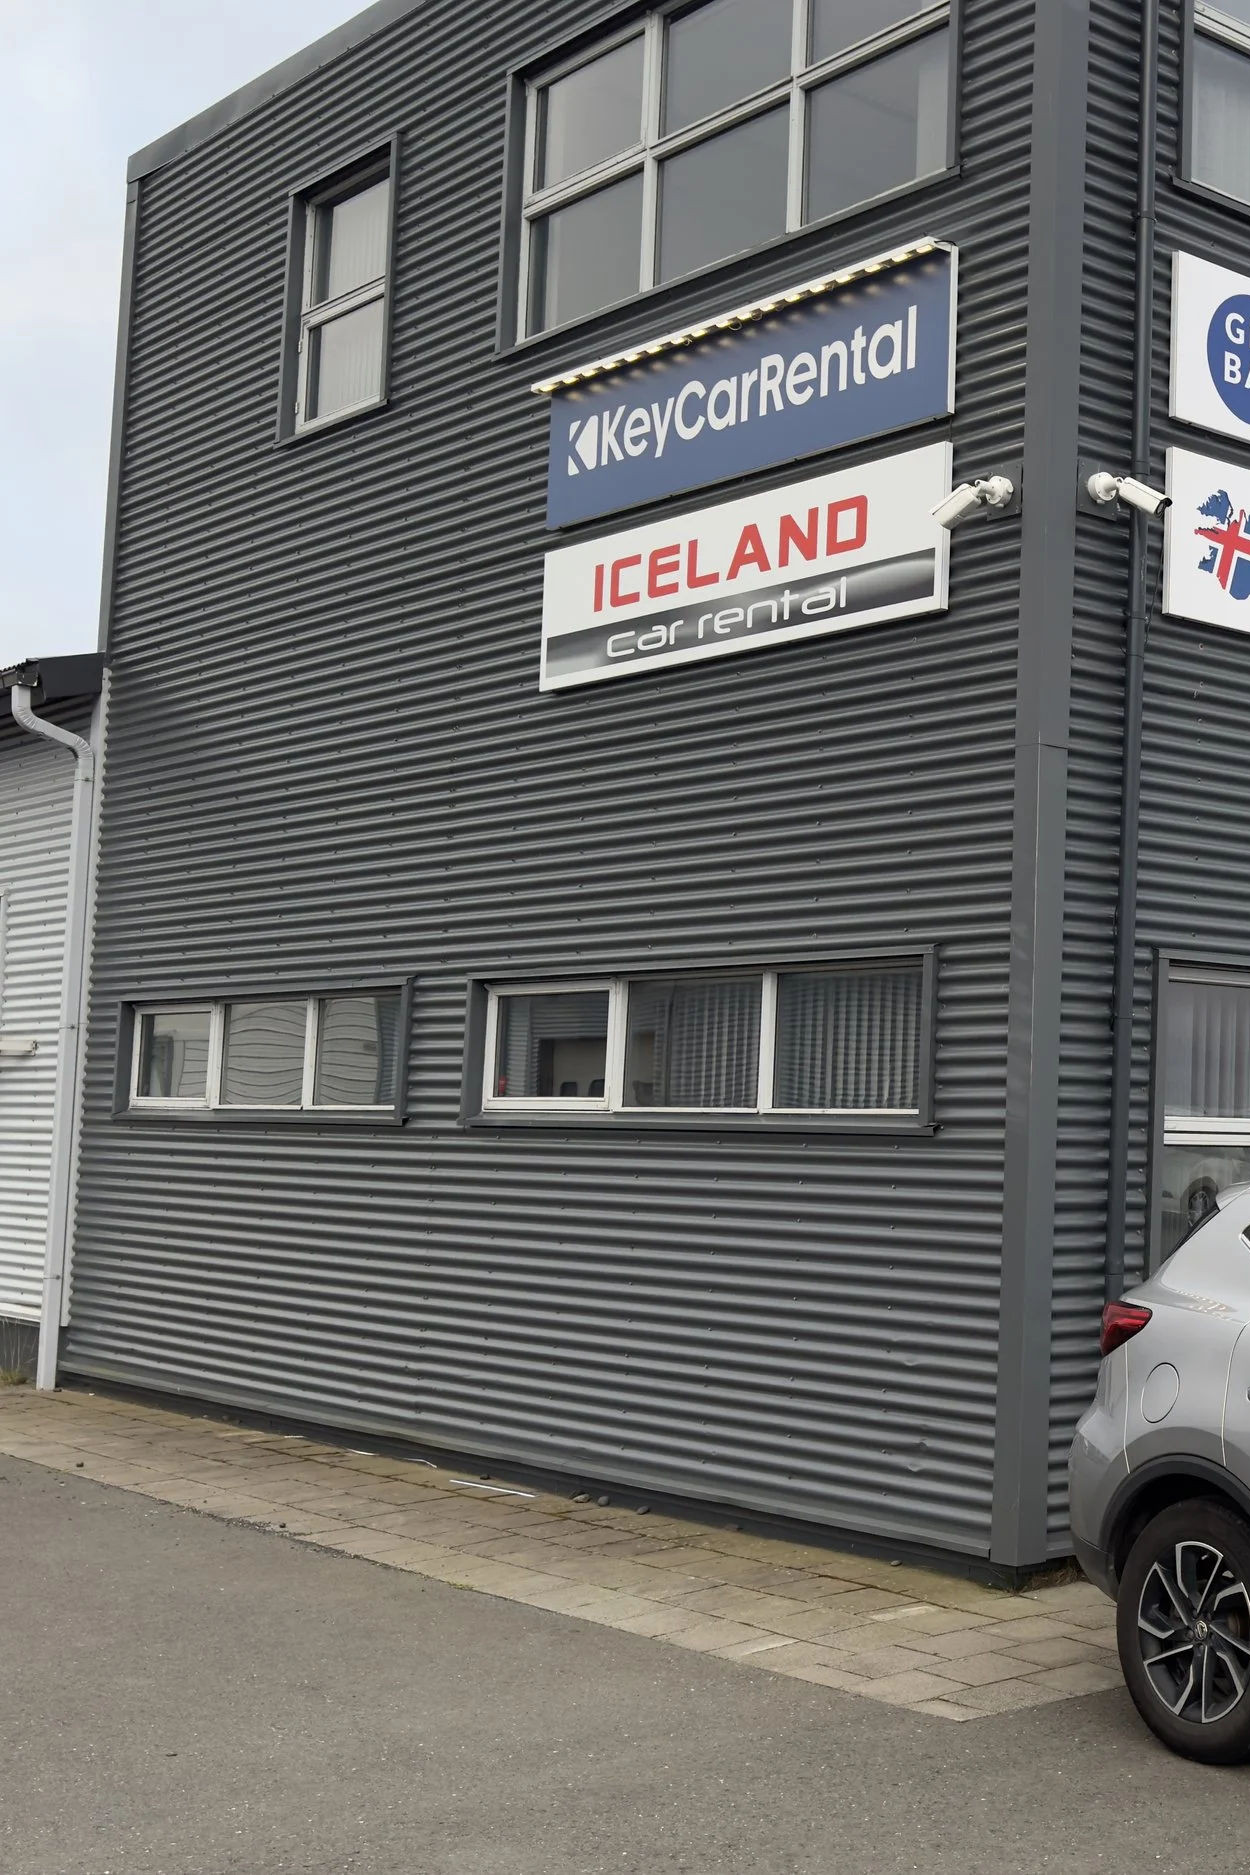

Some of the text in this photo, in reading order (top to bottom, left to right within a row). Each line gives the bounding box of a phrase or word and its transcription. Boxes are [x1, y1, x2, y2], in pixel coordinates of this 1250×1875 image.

[601, 305, 917, 467] KeyCarRental
[594, 495, 868, 613] ICELAND
[606, 577, 847, 658] car rental
